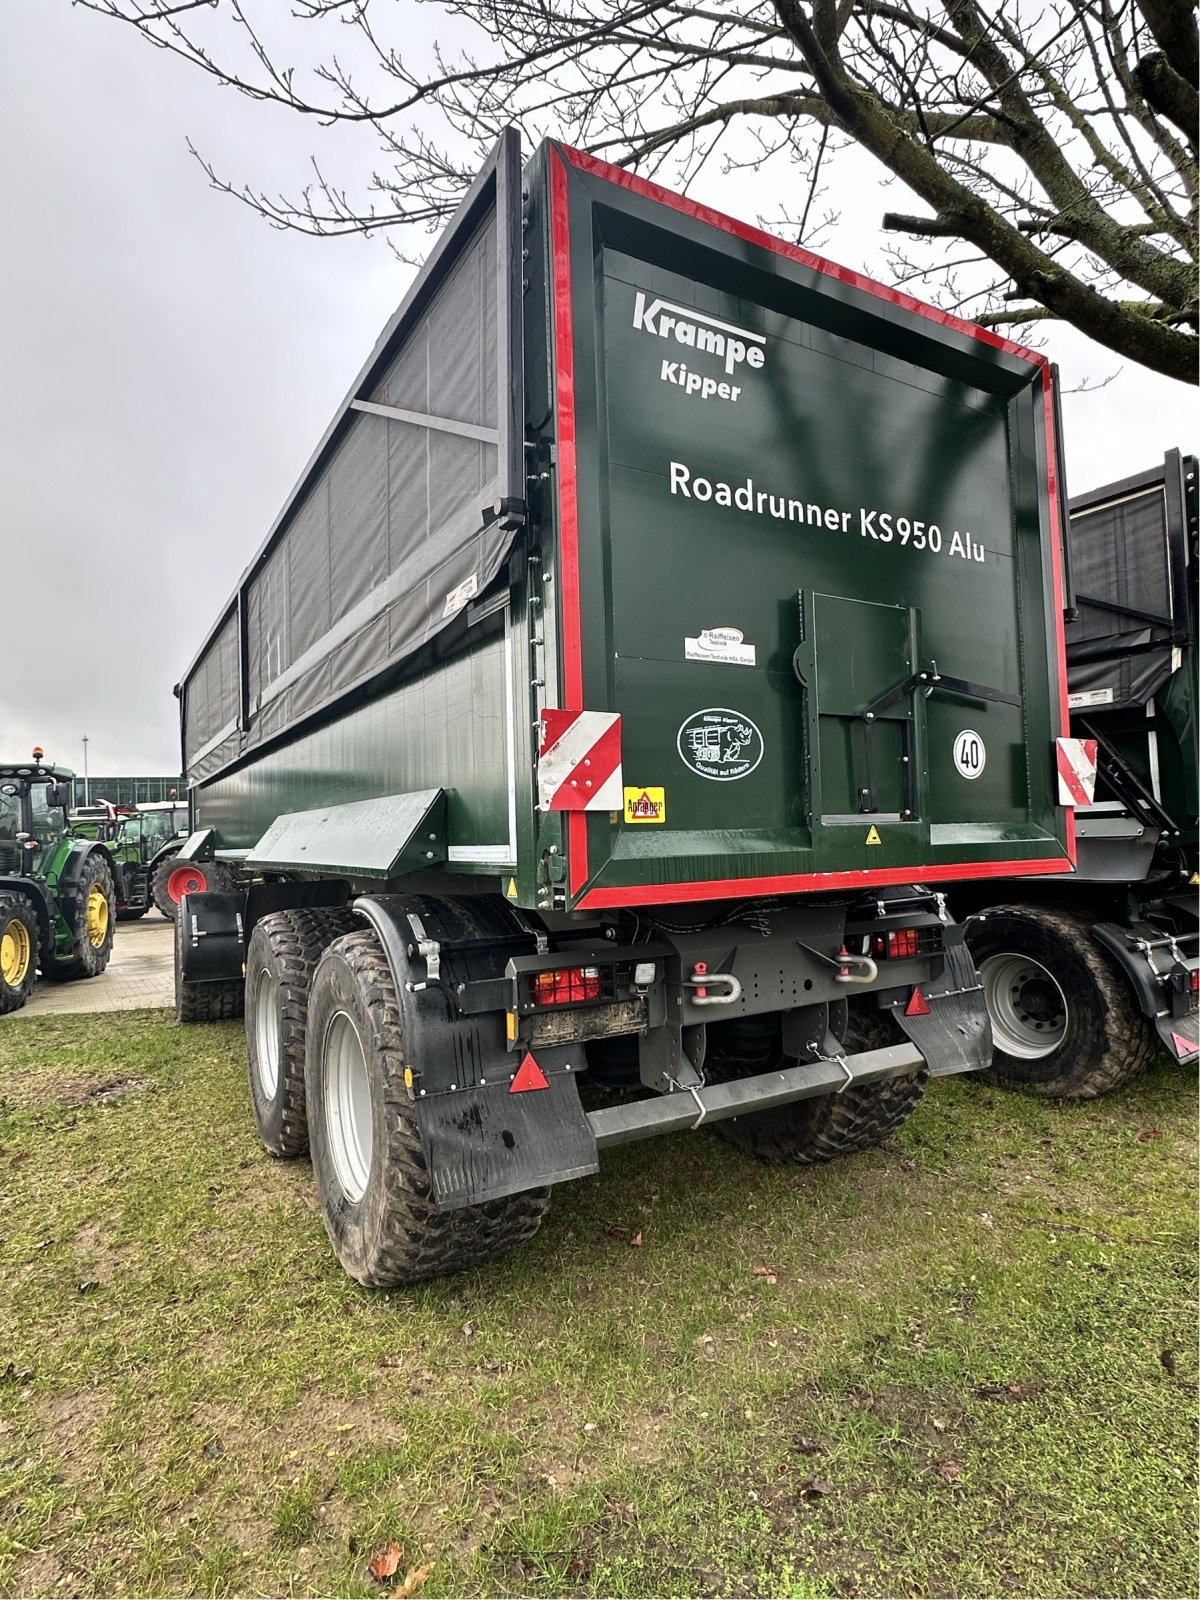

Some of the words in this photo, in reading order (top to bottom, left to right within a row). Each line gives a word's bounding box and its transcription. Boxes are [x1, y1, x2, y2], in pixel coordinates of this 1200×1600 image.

[632, 292, 766, 374] Krampe
[661, 359, 742, 402] Kipper
[669, 461, 852, 532] Roadrunner
[949, 531, 985, 563] Alu
[709, 631, 740, 642] Raiffeisen
[686, 651, 710, 659] Raiffeisen
[710, 653, 728, 661] Technik
[695, 762, 719, 776] Qualität
[719, 768, 729, 776] auf
[961, 739, 978, 769] 40
